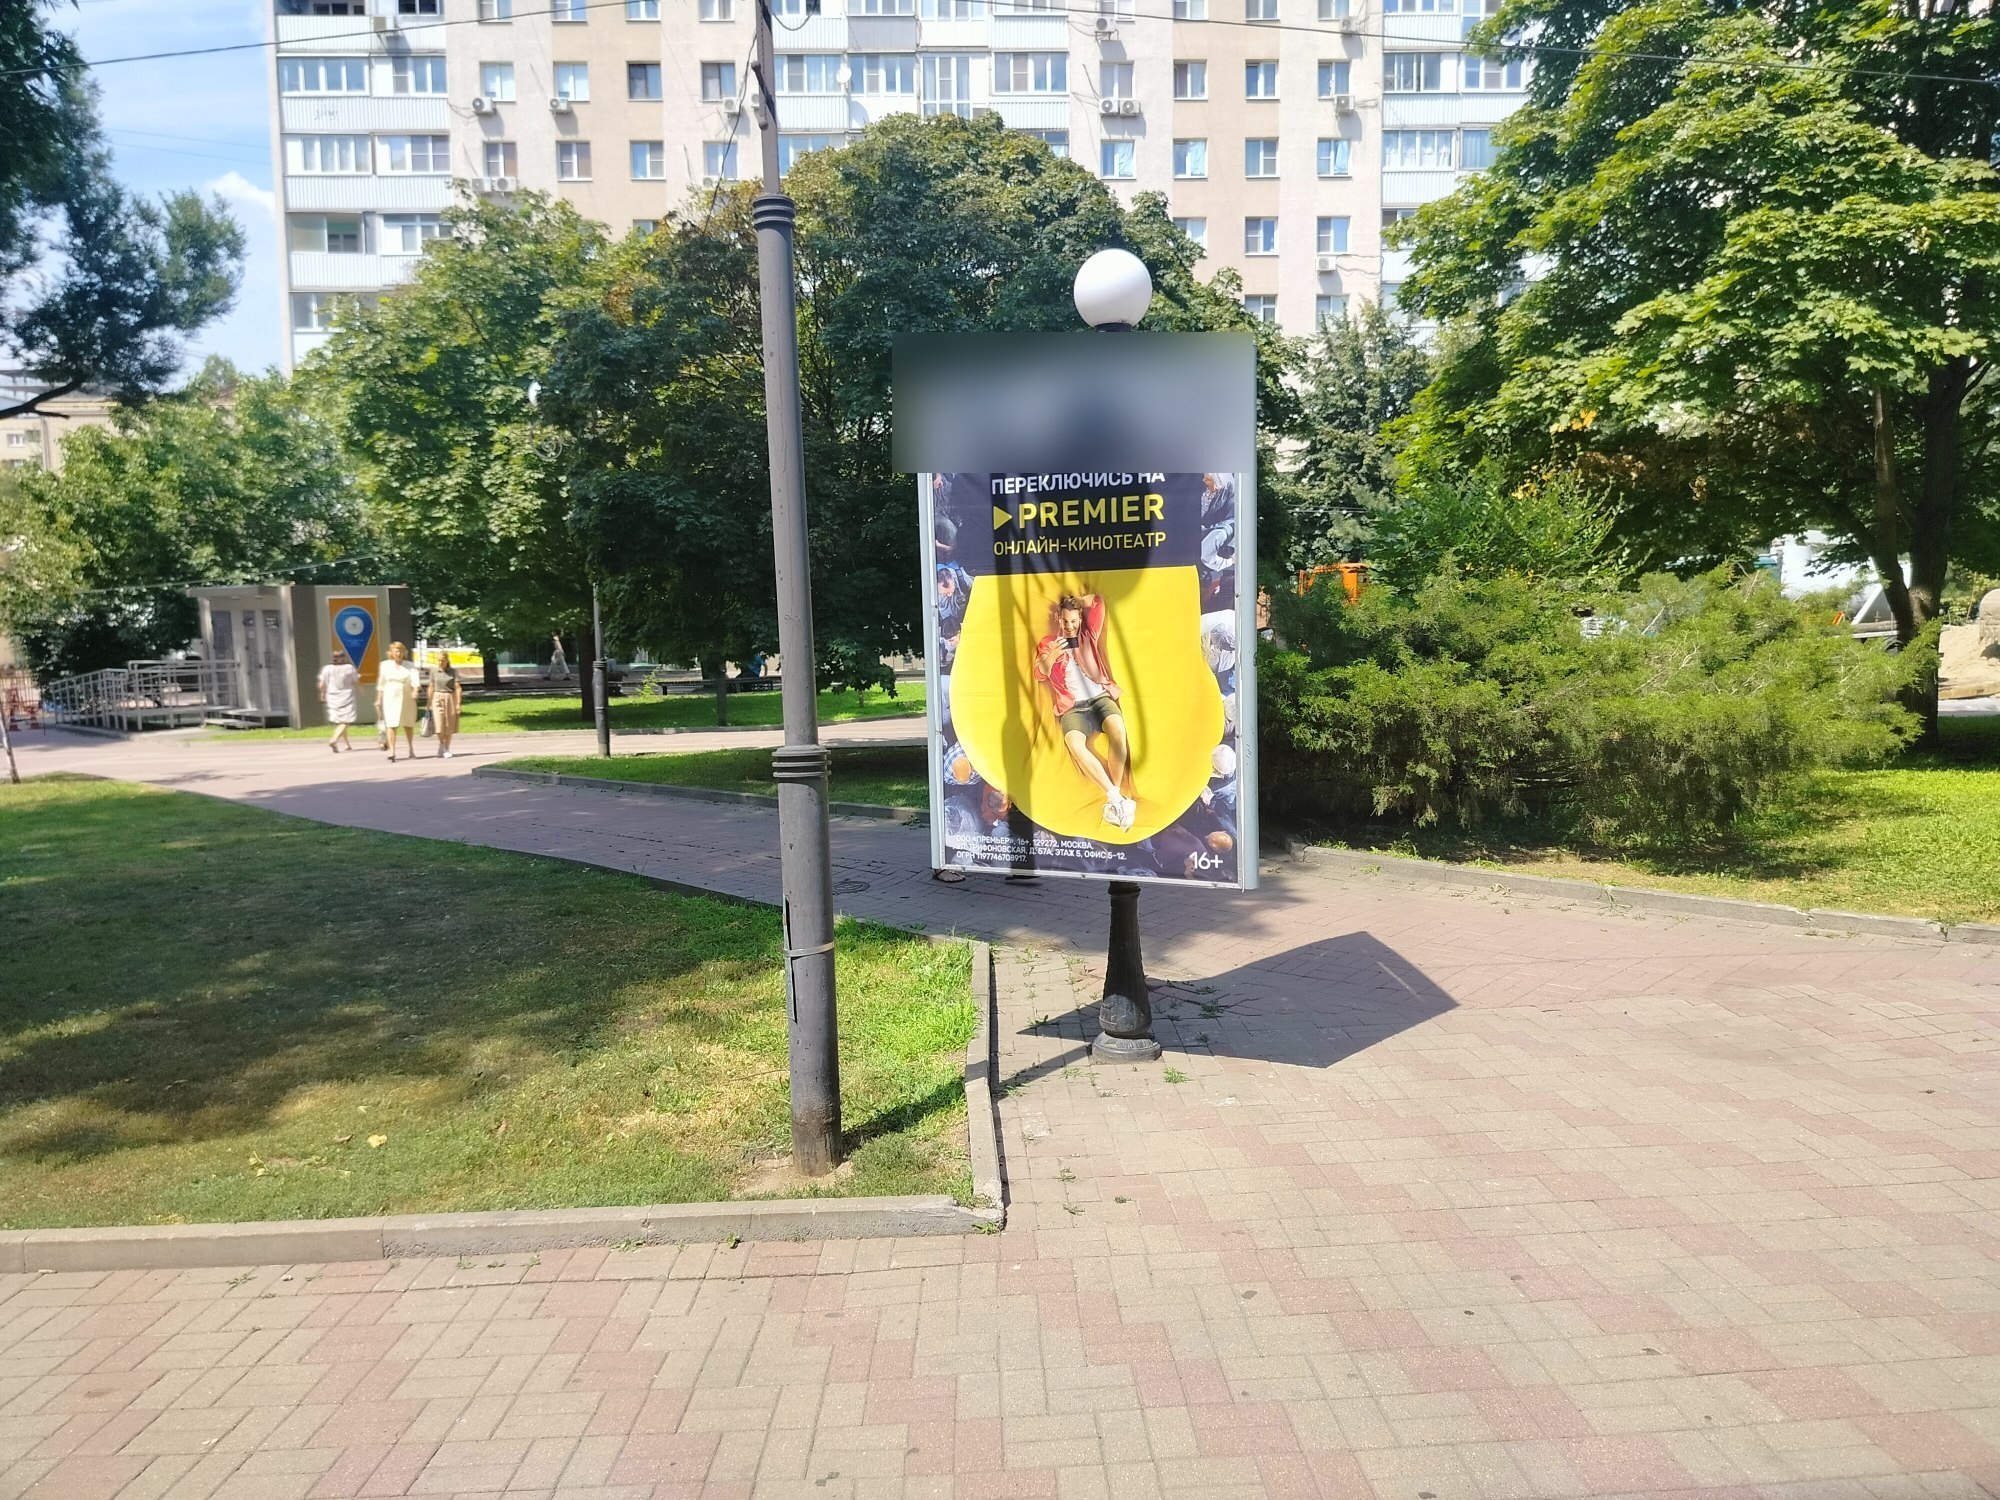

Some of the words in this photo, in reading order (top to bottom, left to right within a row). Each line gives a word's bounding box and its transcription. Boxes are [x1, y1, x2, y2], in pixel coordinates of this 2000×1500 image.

[991, 472, 1133, 495] ПЕРЕКЛЮЧИСЬ
[1018, 493, 1165, 529] PREMIER
[993, 531, 1167, 556] ОНЛАЙН-КИНОТЕАТР
[1055, 848, 1075, 857] ЭТАЖ
[1084, 850, 1106, 859] ОФИС
[1060, 840, 1094, 850] МОСКВА,
[1189, 851, 1224, 870] 16+
